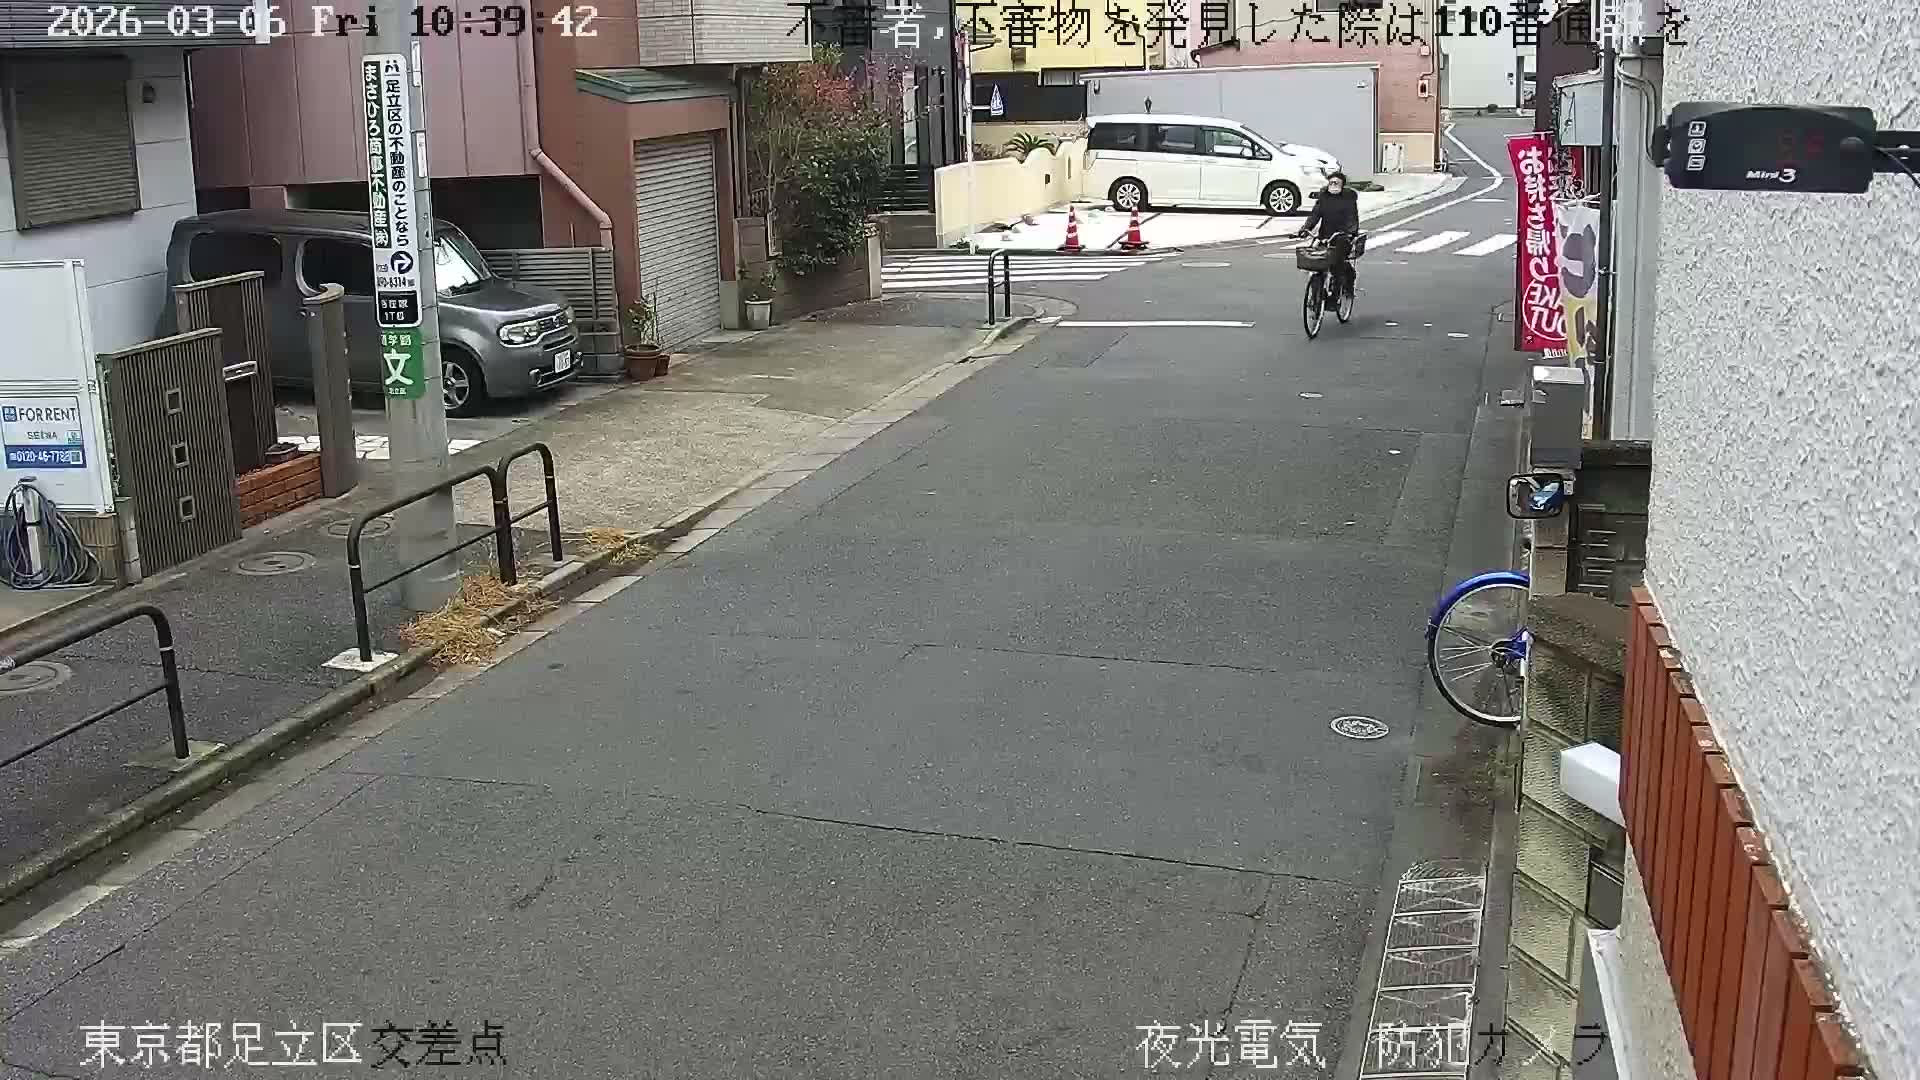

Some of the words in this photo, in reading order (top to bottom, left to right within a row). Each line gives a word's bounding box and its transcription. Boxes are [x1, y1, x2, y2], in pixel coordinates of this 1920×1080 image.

[385, 79, 410, 247] 足立区の不動産のことなら
[383, 347, 414, 385] 文
[18, 407, 43, 421] FOR
[45, 407, 76, 421] RENT
